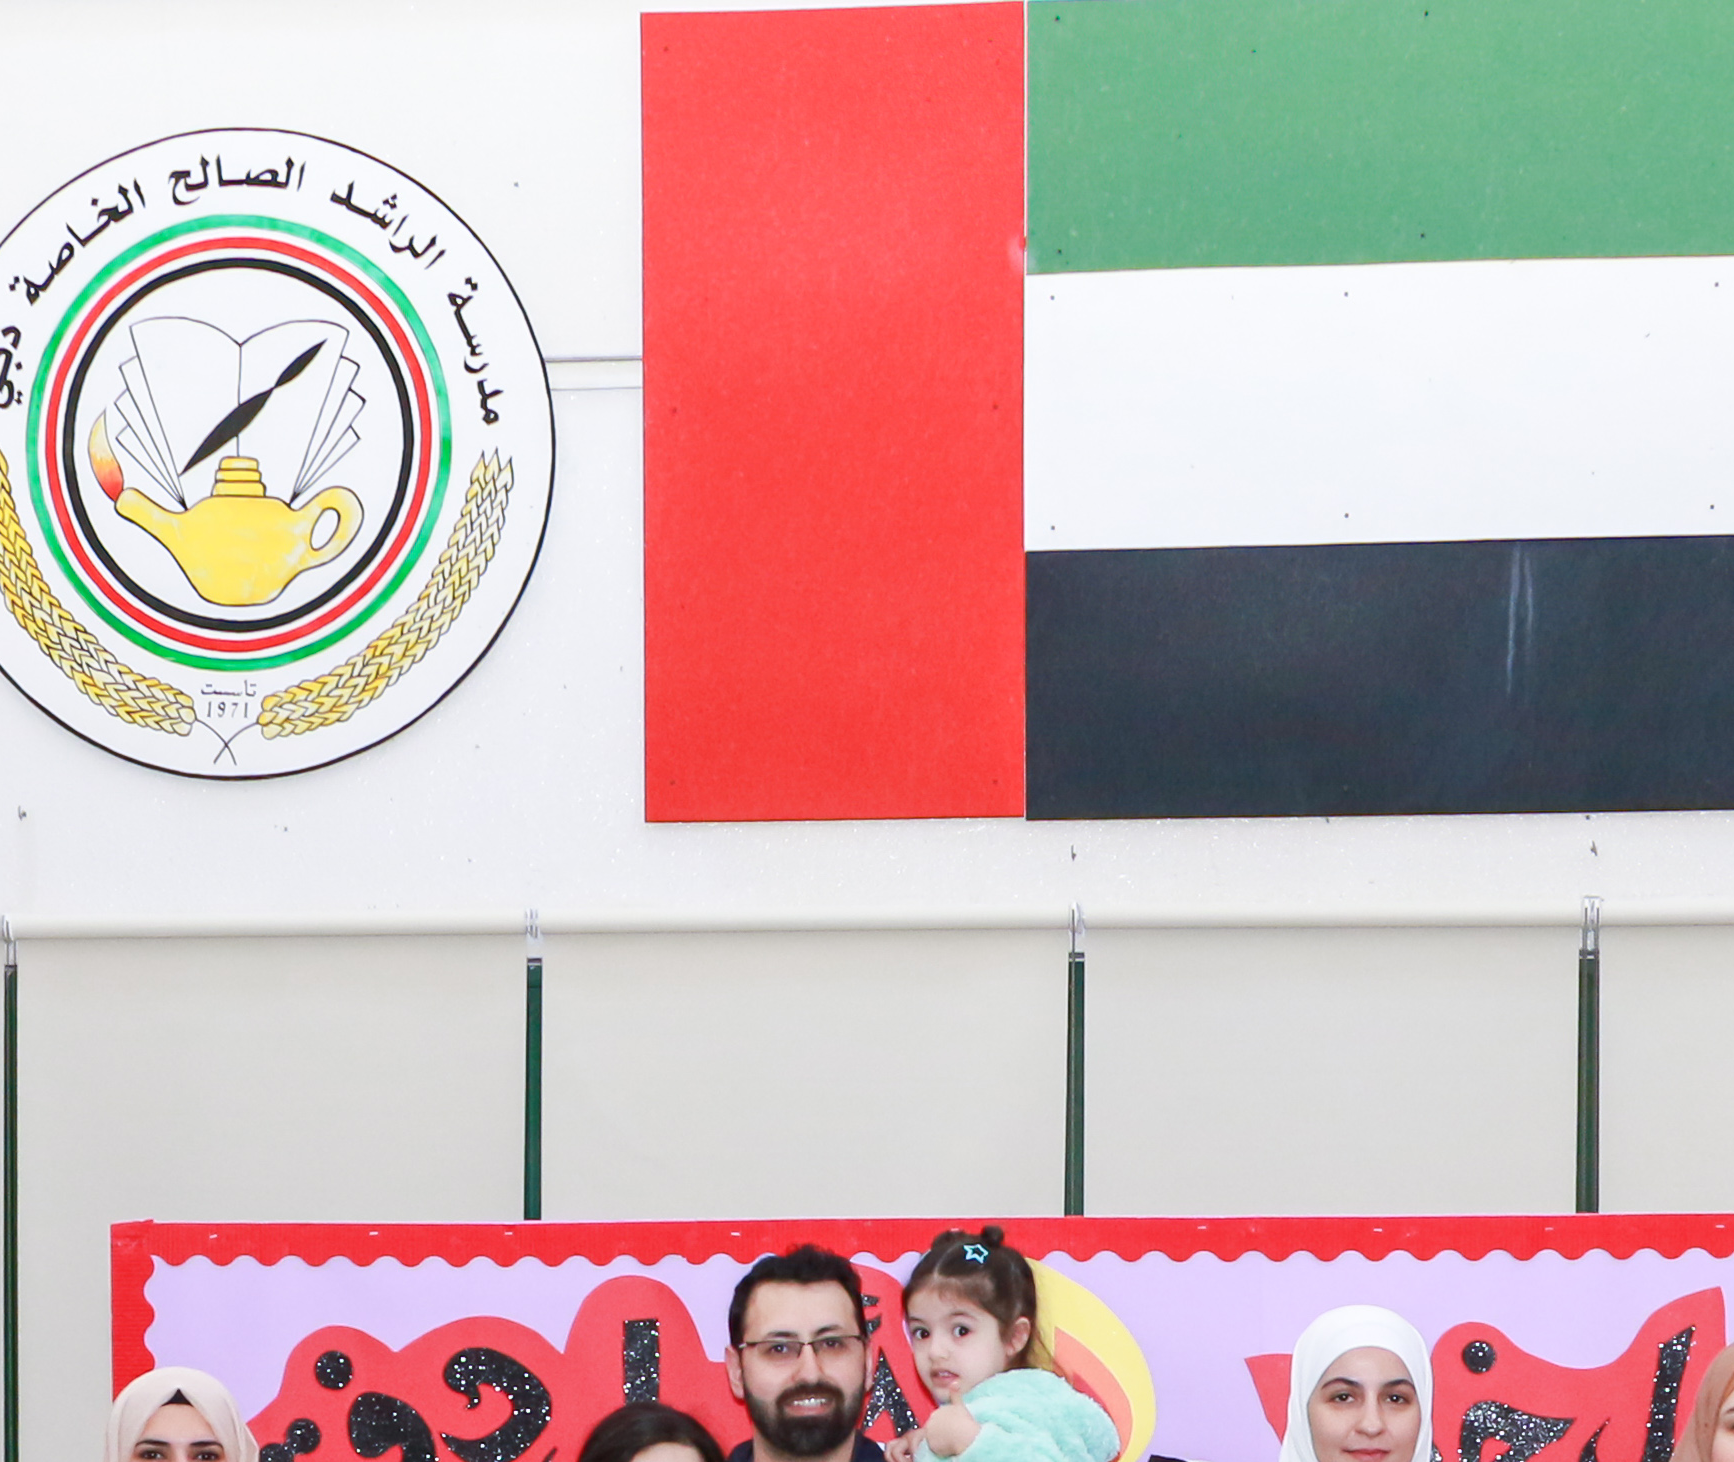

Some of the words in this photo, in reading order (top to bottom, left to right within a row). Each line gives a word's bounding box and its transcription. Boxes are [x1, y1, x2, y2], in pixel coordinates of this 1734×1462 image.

[169, 155, 306, 206] الصالح
[330, 180, 446, 270] الراشد
[9, 178, 146, 305] الخاصة
[448, 277, 503, 424] مدرسة
[207, 701, 248, 718] 1971
